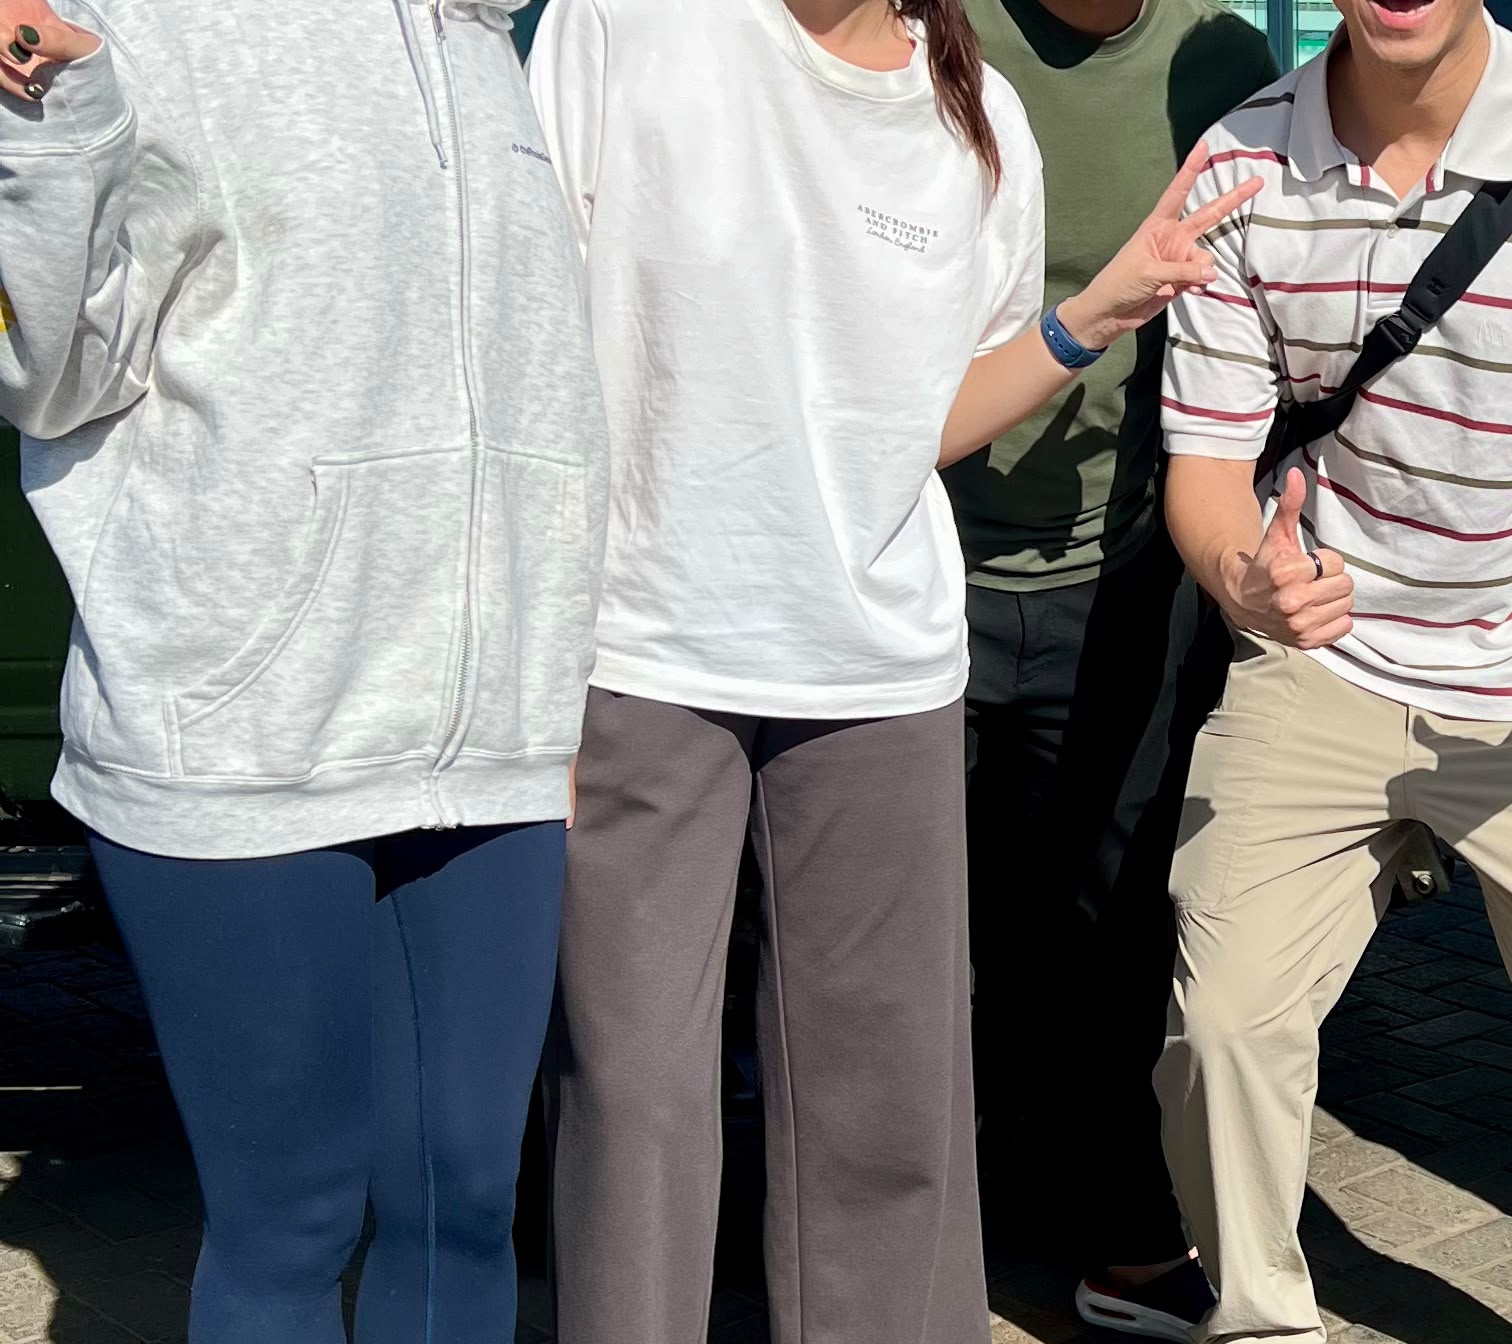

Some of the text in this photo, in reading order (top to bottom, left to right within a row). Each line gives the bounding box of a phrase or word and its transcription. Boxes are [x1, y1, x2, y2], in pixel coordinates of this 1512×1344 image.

[857, 205, 939, 237] ABERCROMBIE
[865, 217, 928, 244] AND FITCH
